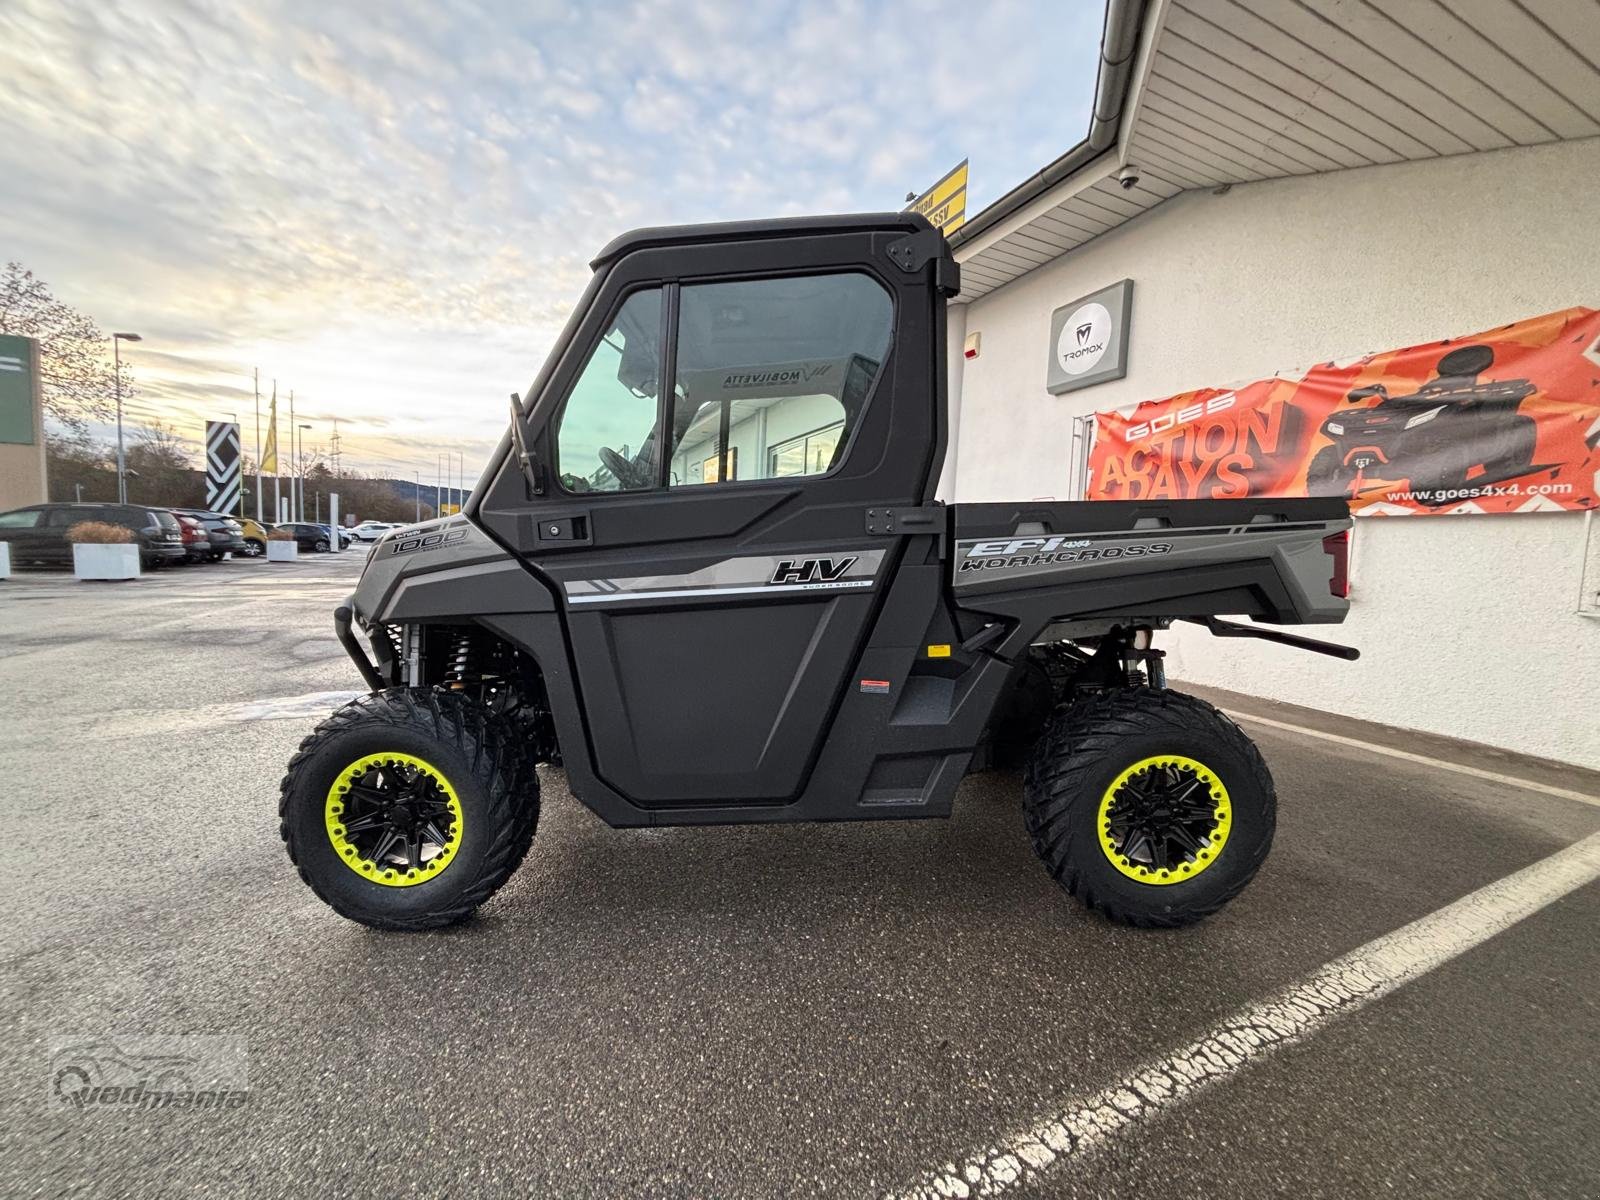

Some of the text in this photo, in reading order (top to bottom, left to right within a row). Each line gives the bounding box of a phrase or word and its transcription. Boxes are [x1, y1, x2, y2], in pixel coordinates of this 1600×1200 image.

[1063, 342, 1104, 362] TROMOX
[1125, 391, 1237, 442] GOES
[1100, 400, 1286, 495] ACTION
[1120, 453, 1255, 499] DAYS
[1386, 482, 1573, 503] www.goes4x4.com
[391, 528, 470, 555] 1000
[966, 537, 1066, 557] EFI
[770, 556, 859, 584] HV
